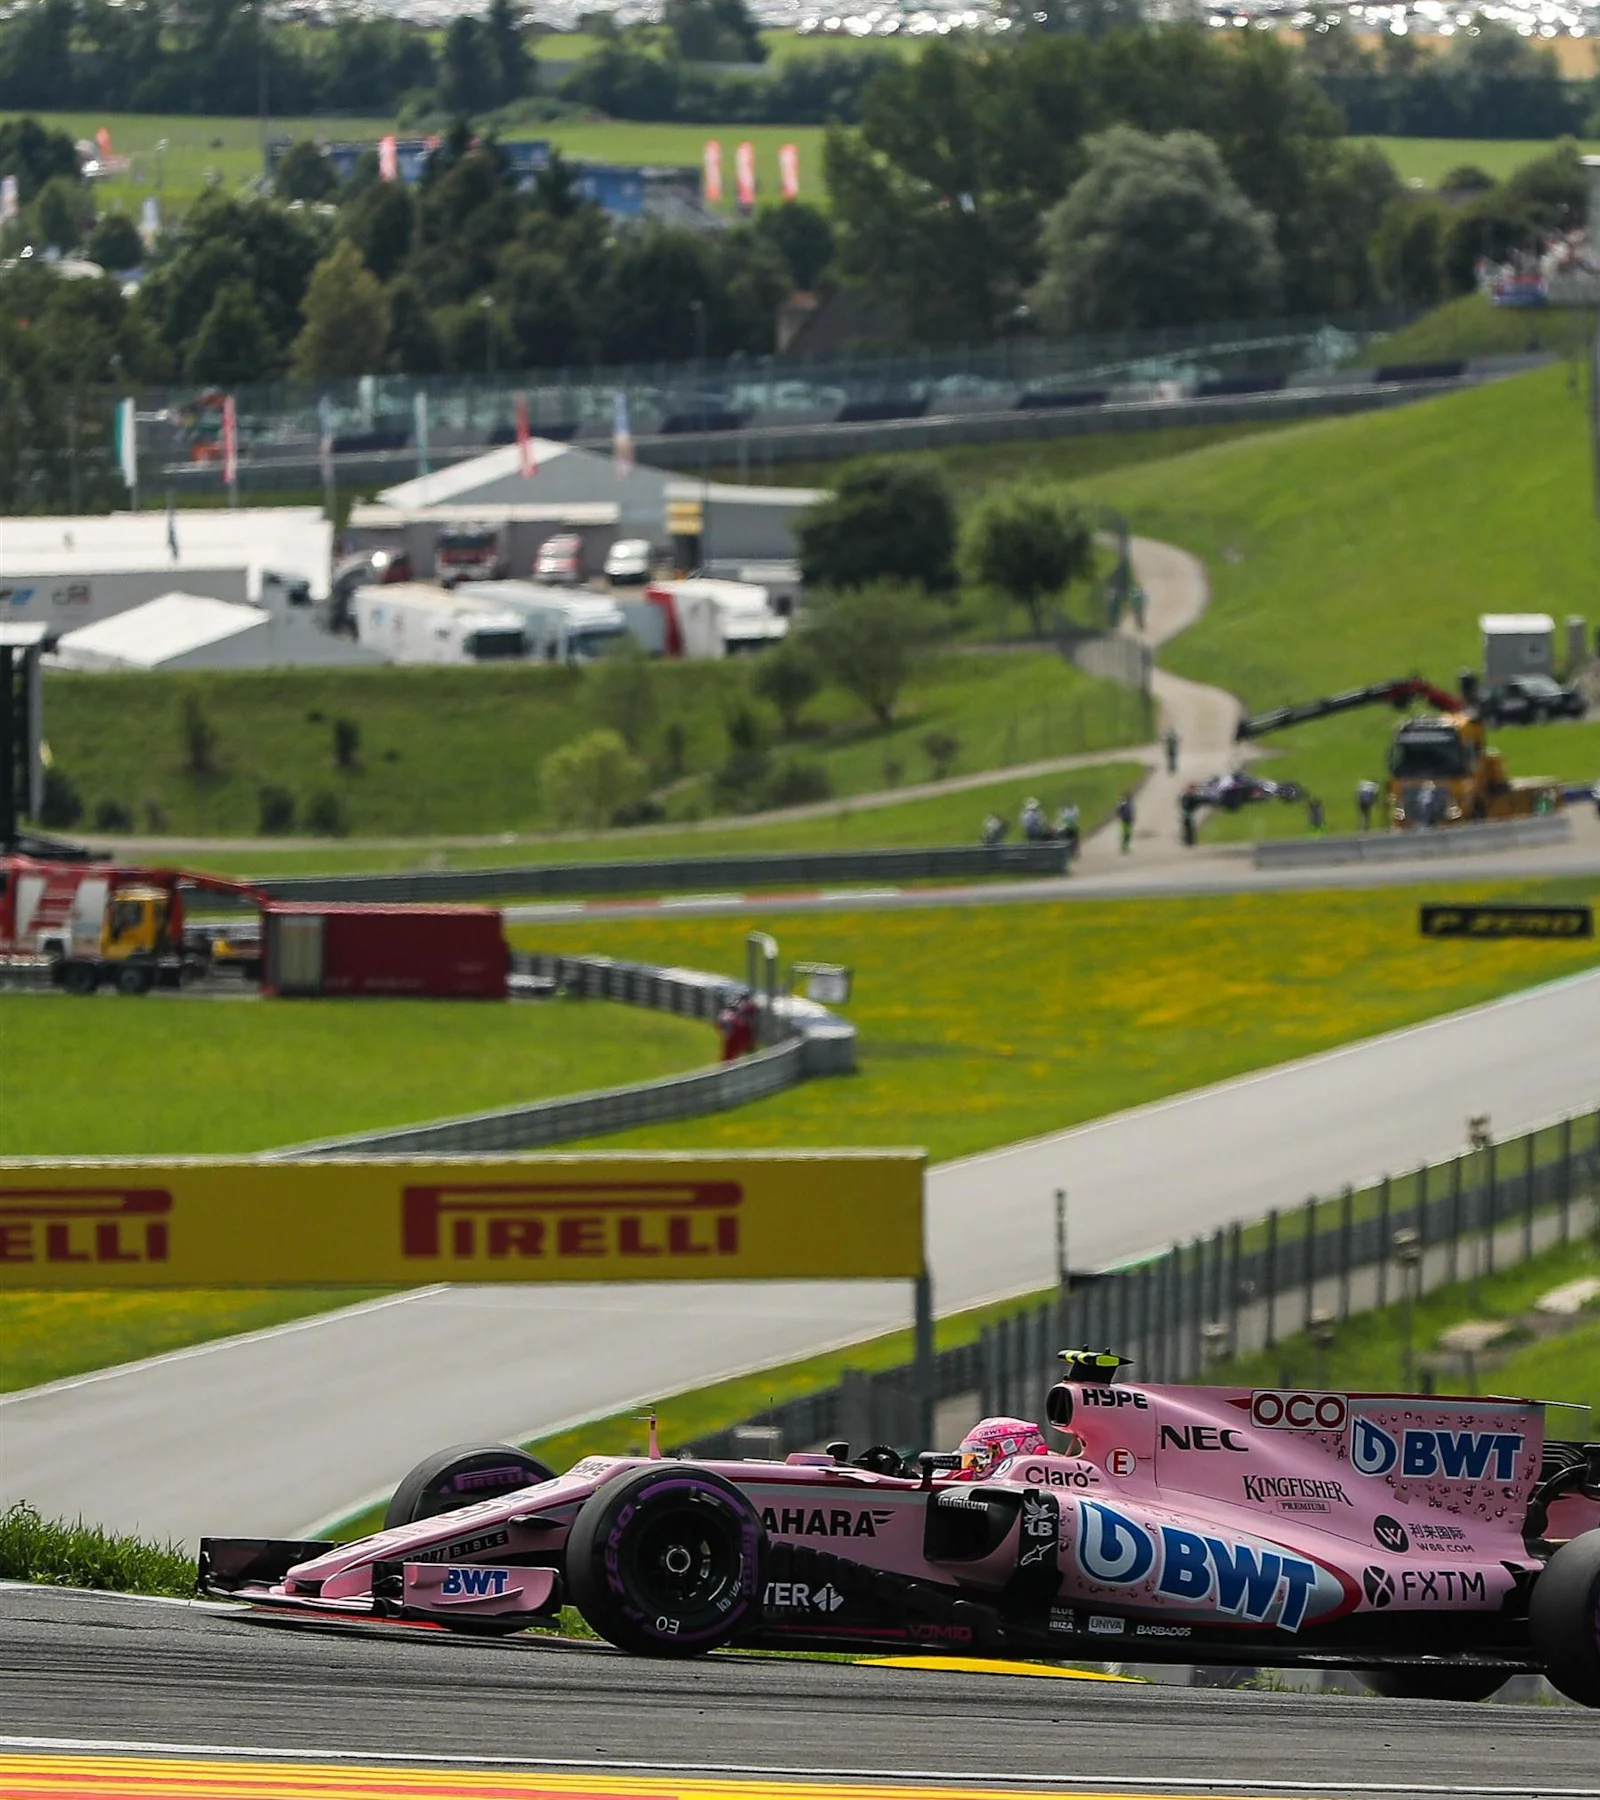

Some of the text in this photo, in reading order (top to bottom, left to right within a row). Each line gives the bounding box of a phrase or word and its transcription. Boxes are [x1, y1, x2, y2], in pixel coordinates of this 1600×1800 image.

[402, 1181, 743, 1259] PIRELLI
[1081, 1388, 1148, 1410] HYPE
[1253, 1393, 1346, 1429] OCO
[1160, 1425, 1249, 1452] NEC
[1113, 1451, 1129, 1475] E
[1401, 1429, 1525, 1482] BWT
[1026, 1465, 1089, 1488] Claro
[938, 1494, 989, 1512] infinitum
[1242, 1475, 1354, 1507] KINGFISHER
[1280, 1502, 1327, 1512] PREMIUM
[453, 1533, 505, 1556] BIBLE
[441, 1567, 509, 1597] BWT
[1156, 1524, 1320, 1634] BWT
[1402, 1571, 1486, 1601] FXTM
[1049, 1621, 1074, 1630] IBIZA
[1136, 1624, 1192, 1637] BARBADOS
